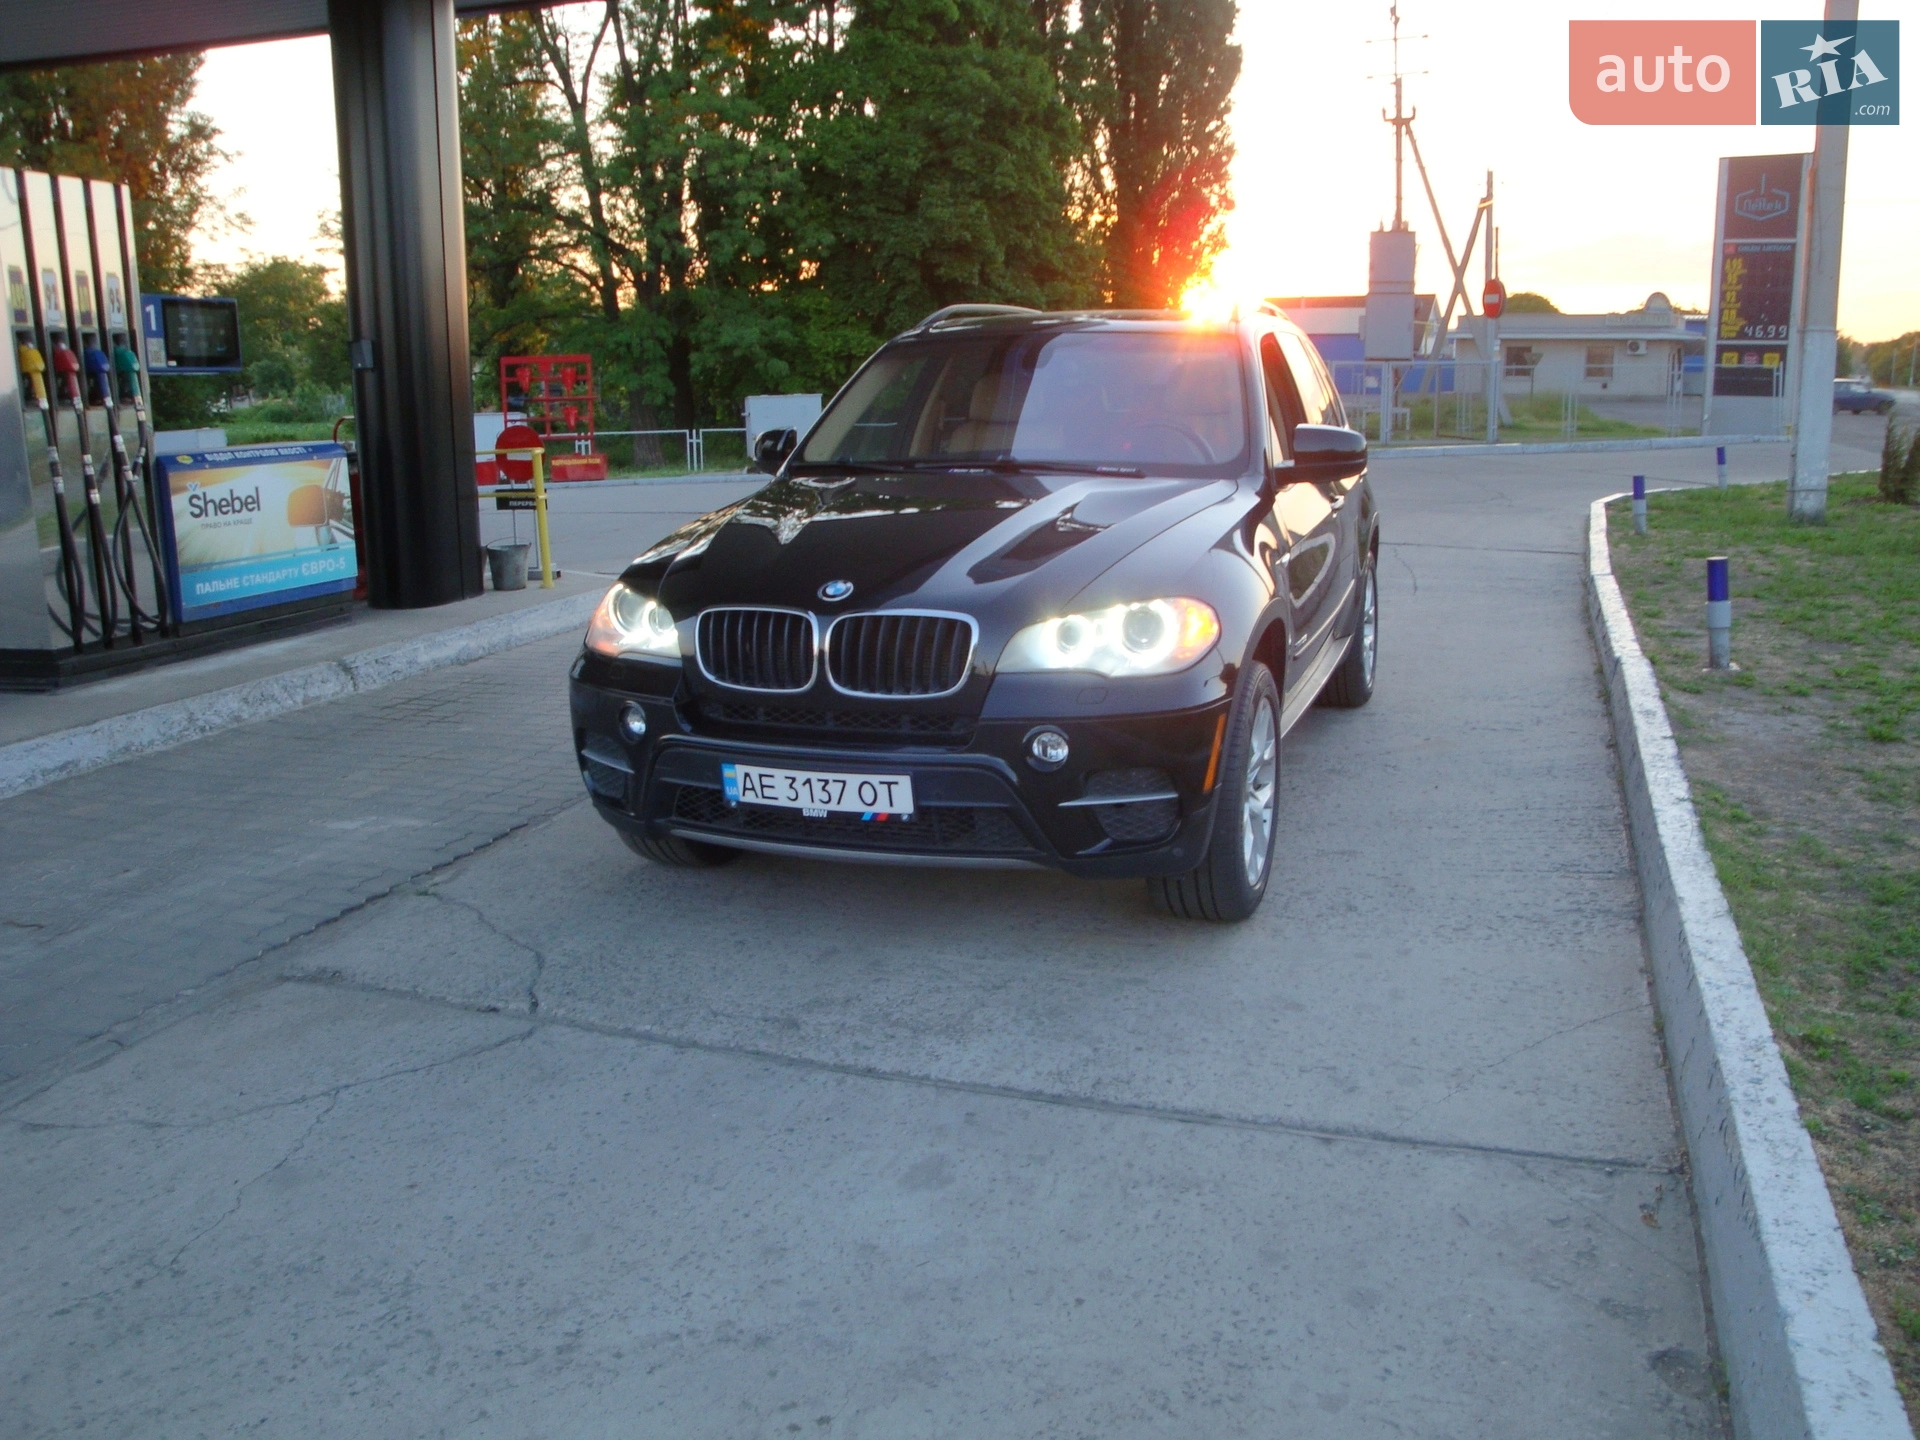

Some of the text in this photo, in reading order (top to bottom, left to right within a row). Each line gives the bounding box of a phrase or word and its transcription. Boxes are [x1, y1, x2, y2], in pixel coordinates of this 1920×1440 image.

[145, 304, 157, 331] 1
[188, 486, 261, 519] Shebel
[196, 557, 346, 595] ПАЛЬНЕ СТАНДАРТУ ЄВРО-5
[726, 786, 739, 796] UA
[741, 772, 899, 808] AE 3137 OT
[802, 808, 828, 818] BMW
